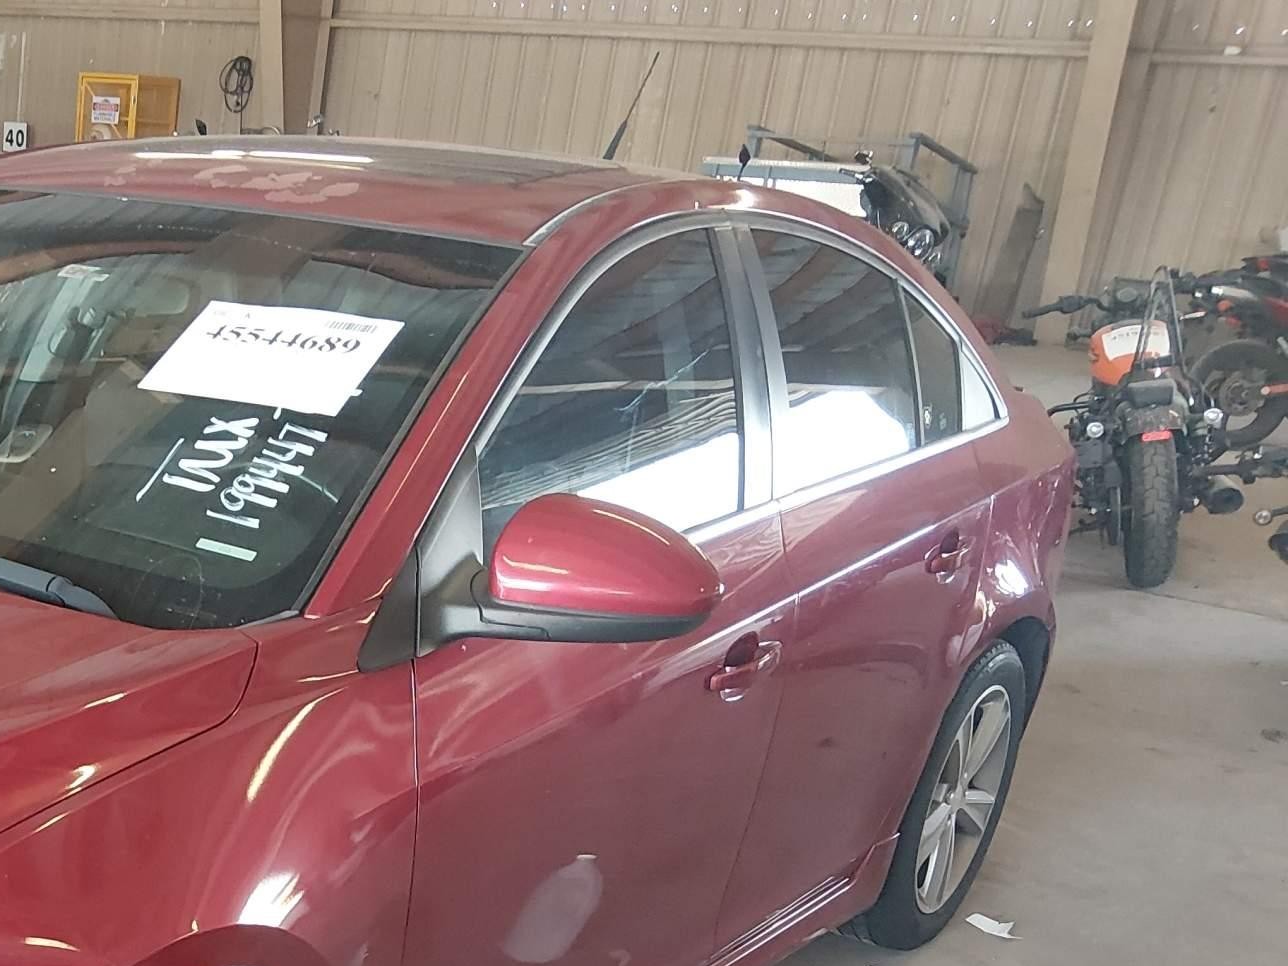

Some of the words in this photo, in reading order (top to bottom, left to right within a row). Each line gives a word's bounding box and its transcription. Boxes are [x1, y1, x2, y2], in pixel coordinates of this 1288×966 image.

[5, 129, 25, 147] 40
[206, 324, 361, 353] 45544689
[205, 422, 329, 529] 199447
